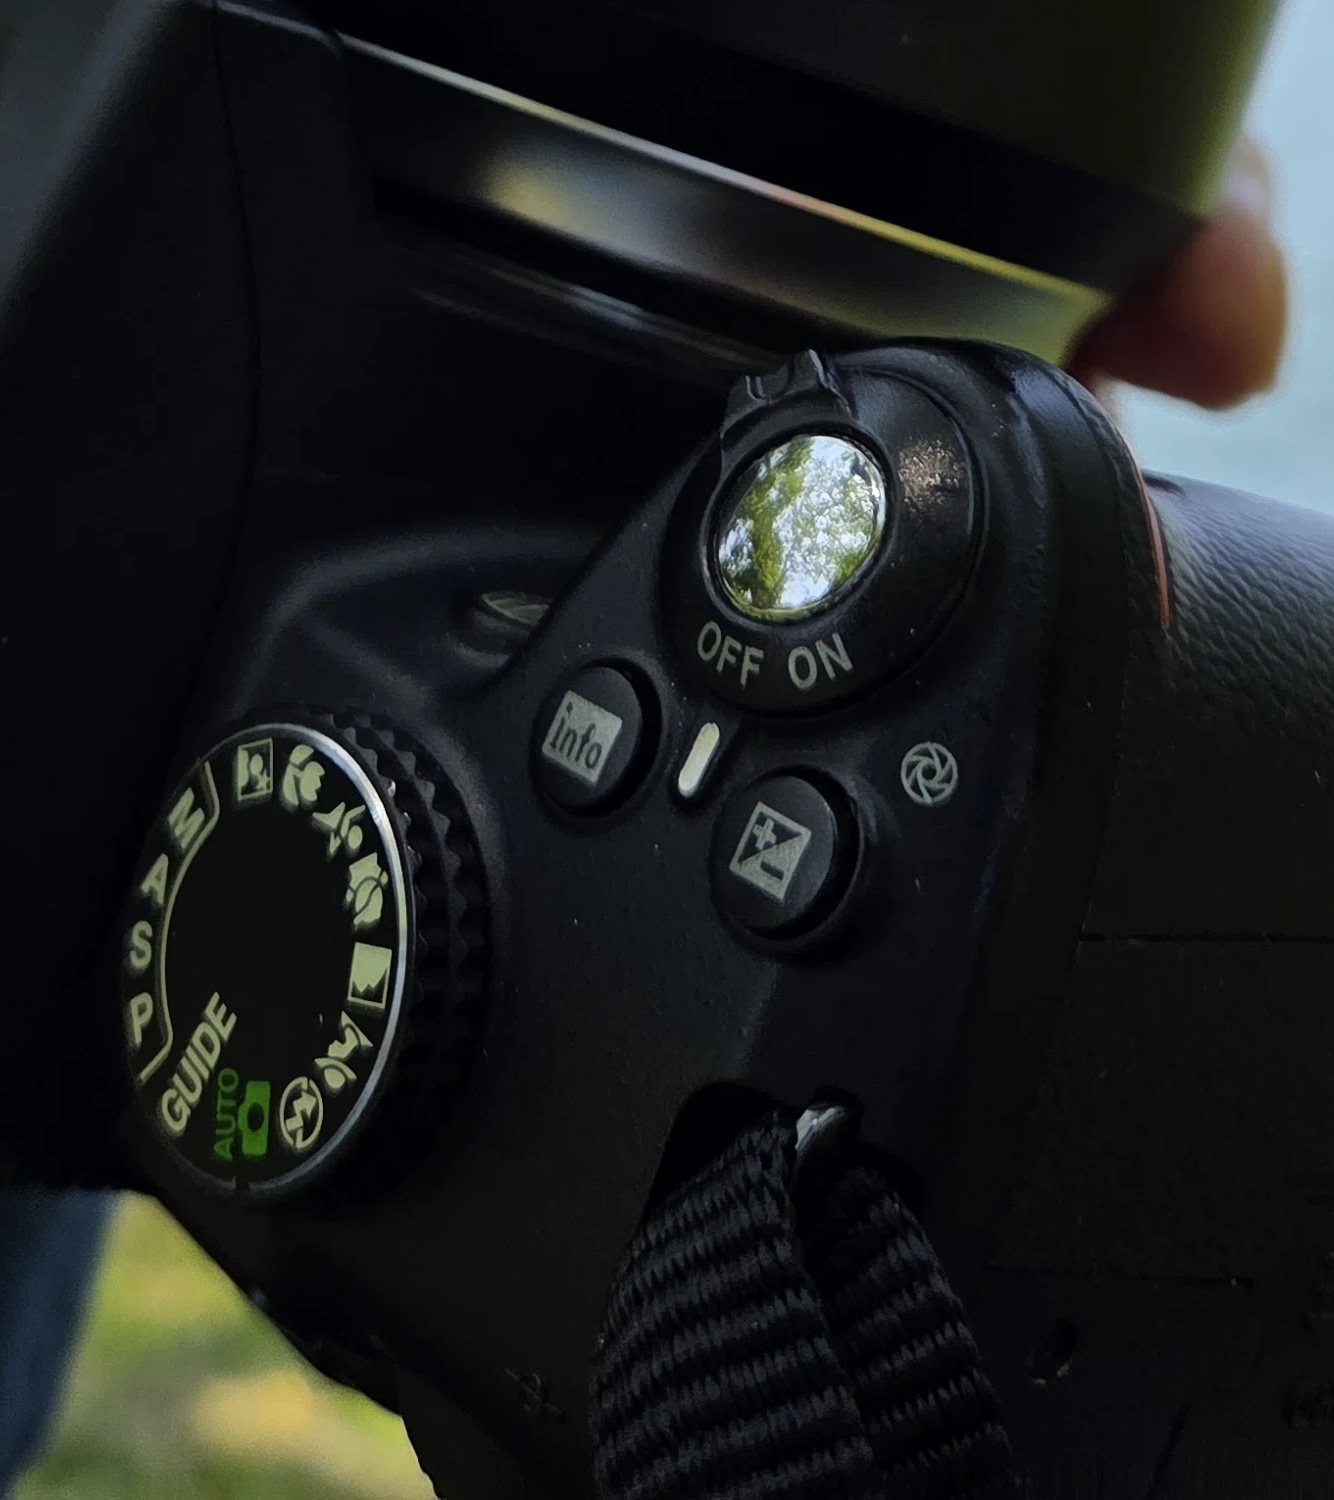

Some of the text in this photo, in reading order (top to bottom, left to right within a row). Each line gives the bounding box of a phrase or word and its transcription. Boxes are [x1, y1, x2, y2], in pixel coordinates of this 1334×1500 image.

[697, 620, 854, 691] OFF ON
[549, 701, 603, 770] info
[168, 787, 205, 848] M
[141, 853, 169, 907] A
[129, 920, 153, 970] S
[128, 991, 154, 1047] P
[161, 991, 237, 1136] GUIDE
[213, 1067, 240, 1161] AUTO
